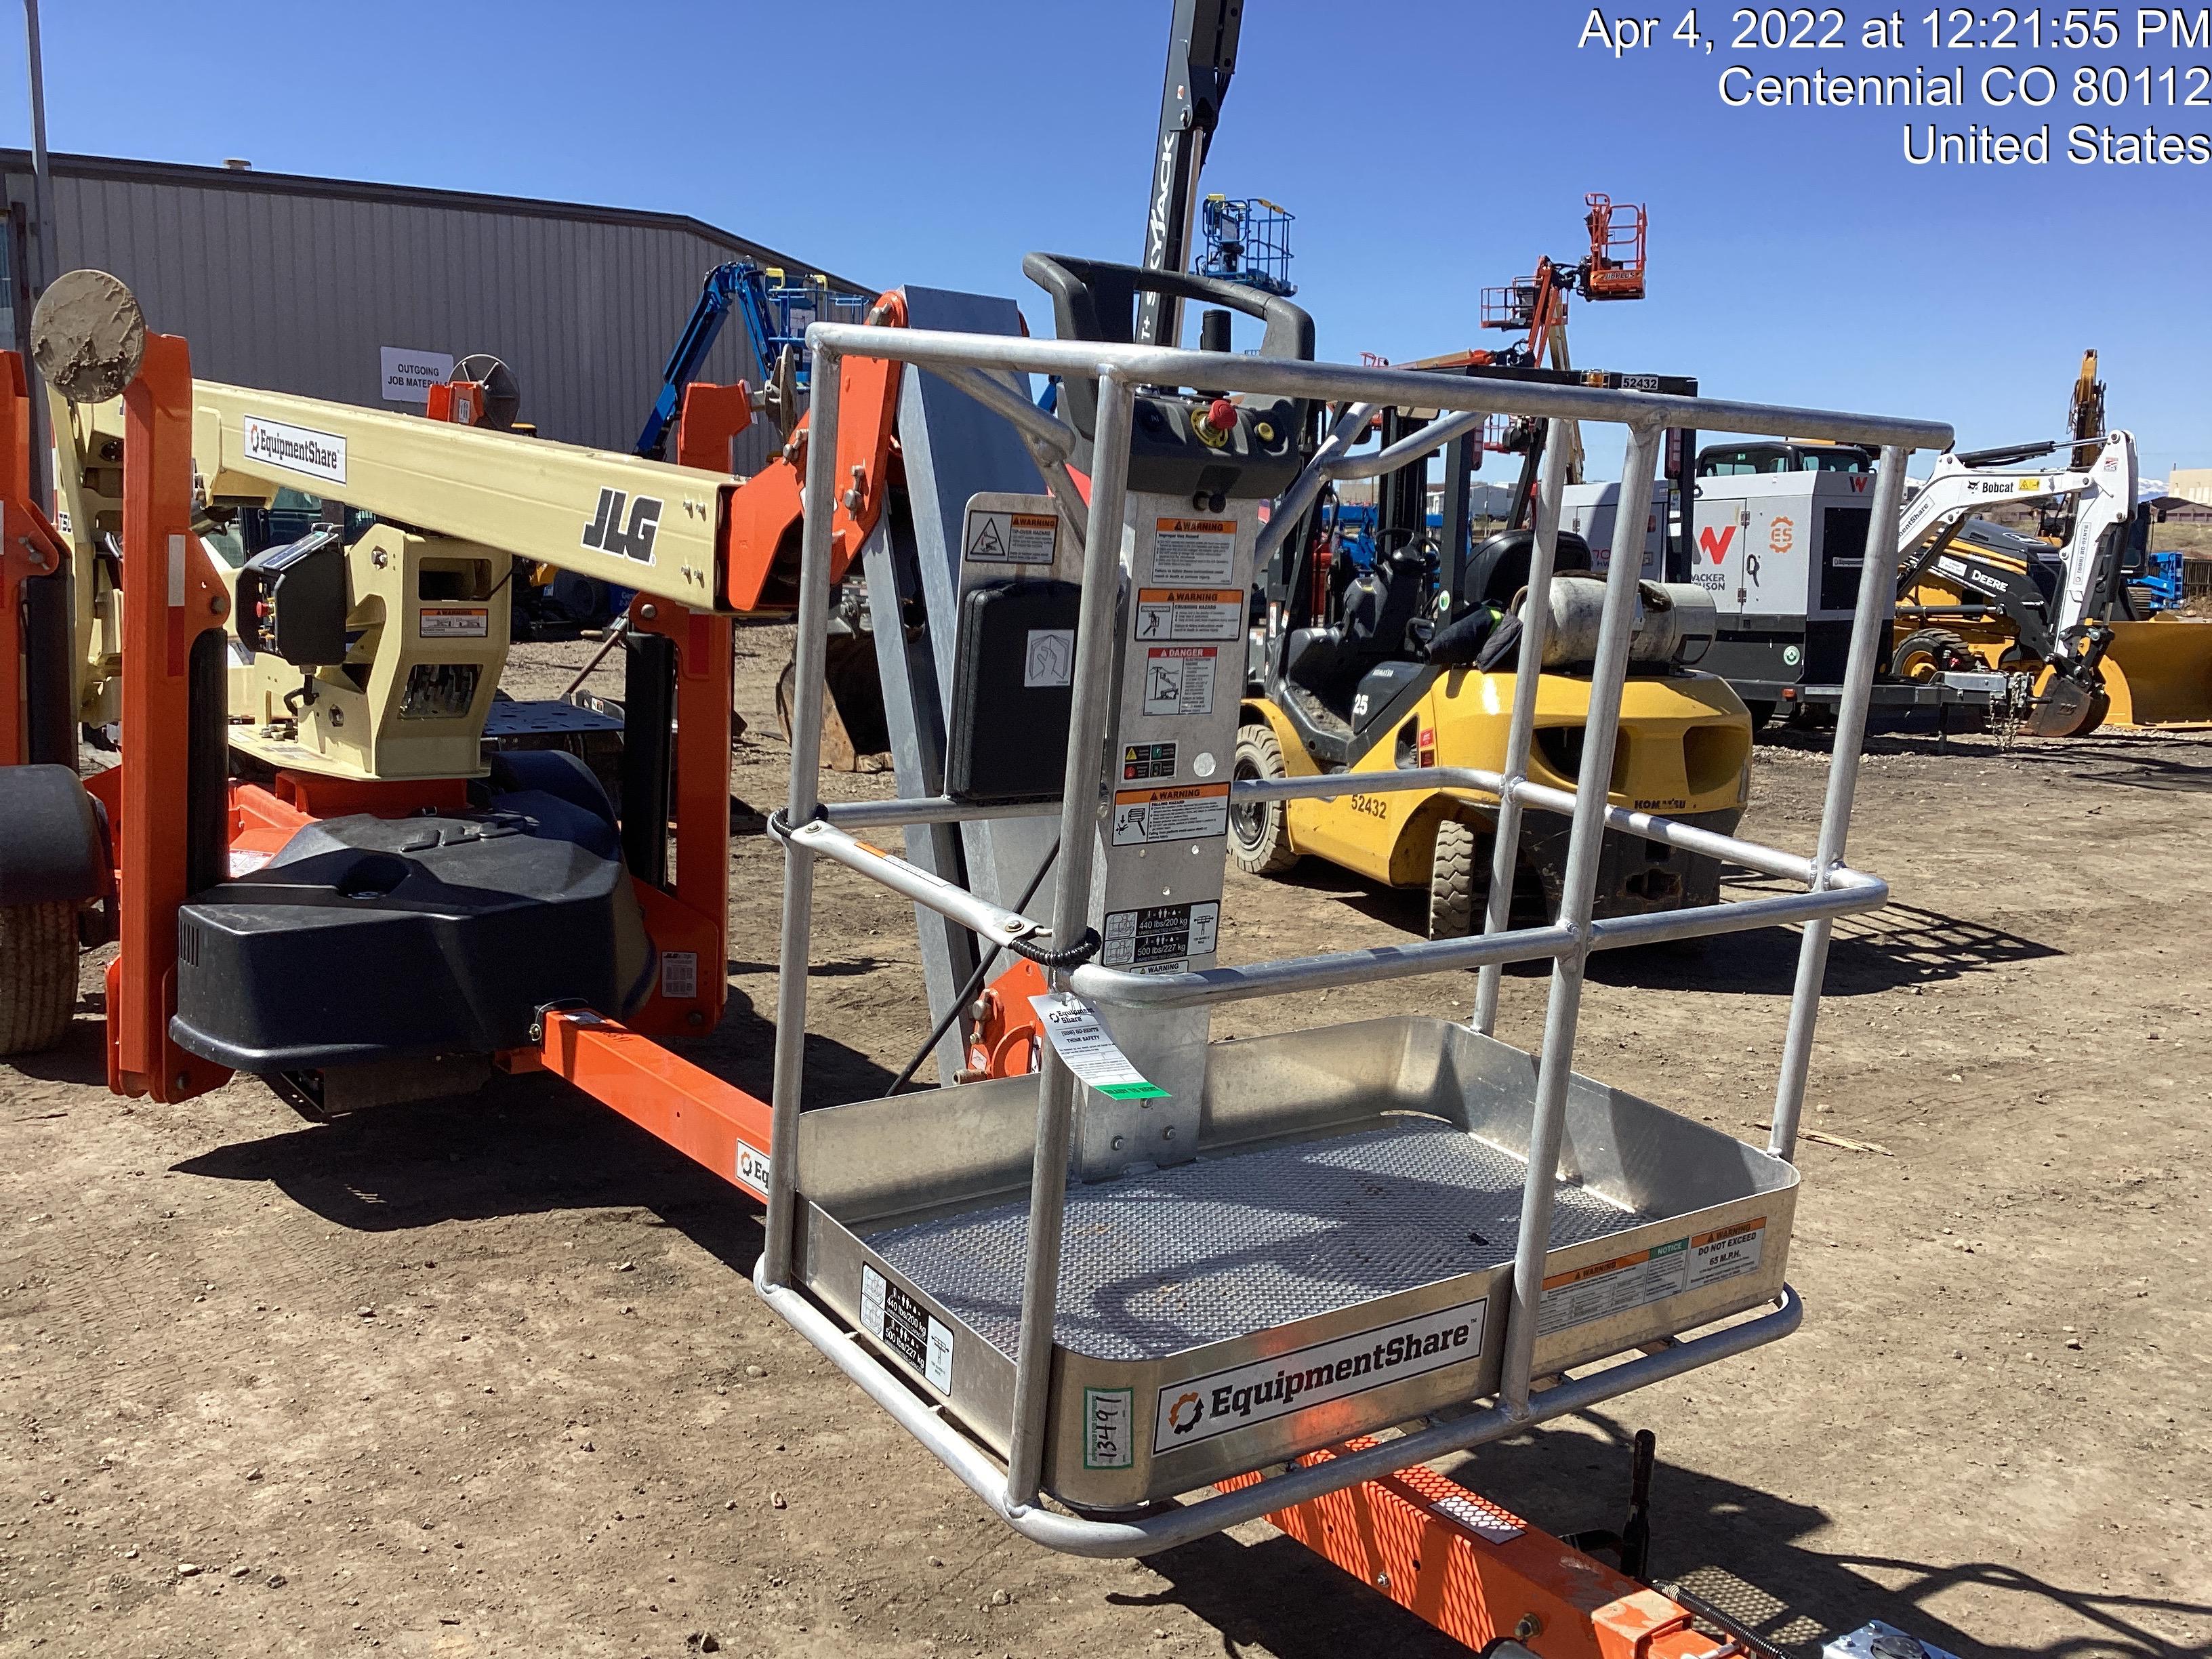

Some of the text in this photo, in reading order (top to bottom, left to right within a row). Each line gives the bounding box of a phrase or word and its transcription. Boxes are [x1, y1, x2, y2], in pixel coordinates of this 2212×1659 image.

[397, 363, 440, 384] OUTGOING
[388, 375, 405, 392] JOB
[1622, 377, 1658, 389] 52432
[260, 428, 338, 470] EquipmentShare
[1982, 482, 2014, 493] Bobcat
[581, 487, 663, 564] JLG
[1020, 517, 1055, 527] WARNING
[1183, 521, 1223, 532] WARNING
[1771, 528, 1793, 542] ES
[1971, 569, 2009, 592] DEERE
[1176, 593, 1218, 602] WARNING
[1168, 649, 1204, 657] DANGER
[1353, 693, 1369, 716] 25
[1160, 789, 1200, 800] WARNING
[1351, 794, 1387, 819] 52432
[1139, 918, 1188, 930] 440 lbs/200 kg
[1137, 947, 1151, 956] 500
[1152, 945, 1176, 954] lbs/227
[1147, 963, 1179, 974] WARNING
[1057, 1007, 1095, 1017] Equipment
[1061, 1016, 1082, 1024] Share
[754, 1160, 769, 1189] Eq
[1717, 1224, 1751, 1240] WARNING
[1658, 1242, 1683, 1254] NOTICE
[1698, 1232, 1757, 1256] DO NOT EXCEED
[1709, 1250, 1741, 1265] 65 M.P.H.
[1583, 1261, 1617, 1277] WARNING
[886, 1296, 926, 1337] 440 lbs/200 kg
[885, 1327, 896, 1343] 500
[897, 1336, 917, 1359] lbs/227
[917, 1353, 924, 1369] kg
[1209, 1323, 1470, 1419] EquipmentShare
[1095, 1395, 1122, 1457] 13491
